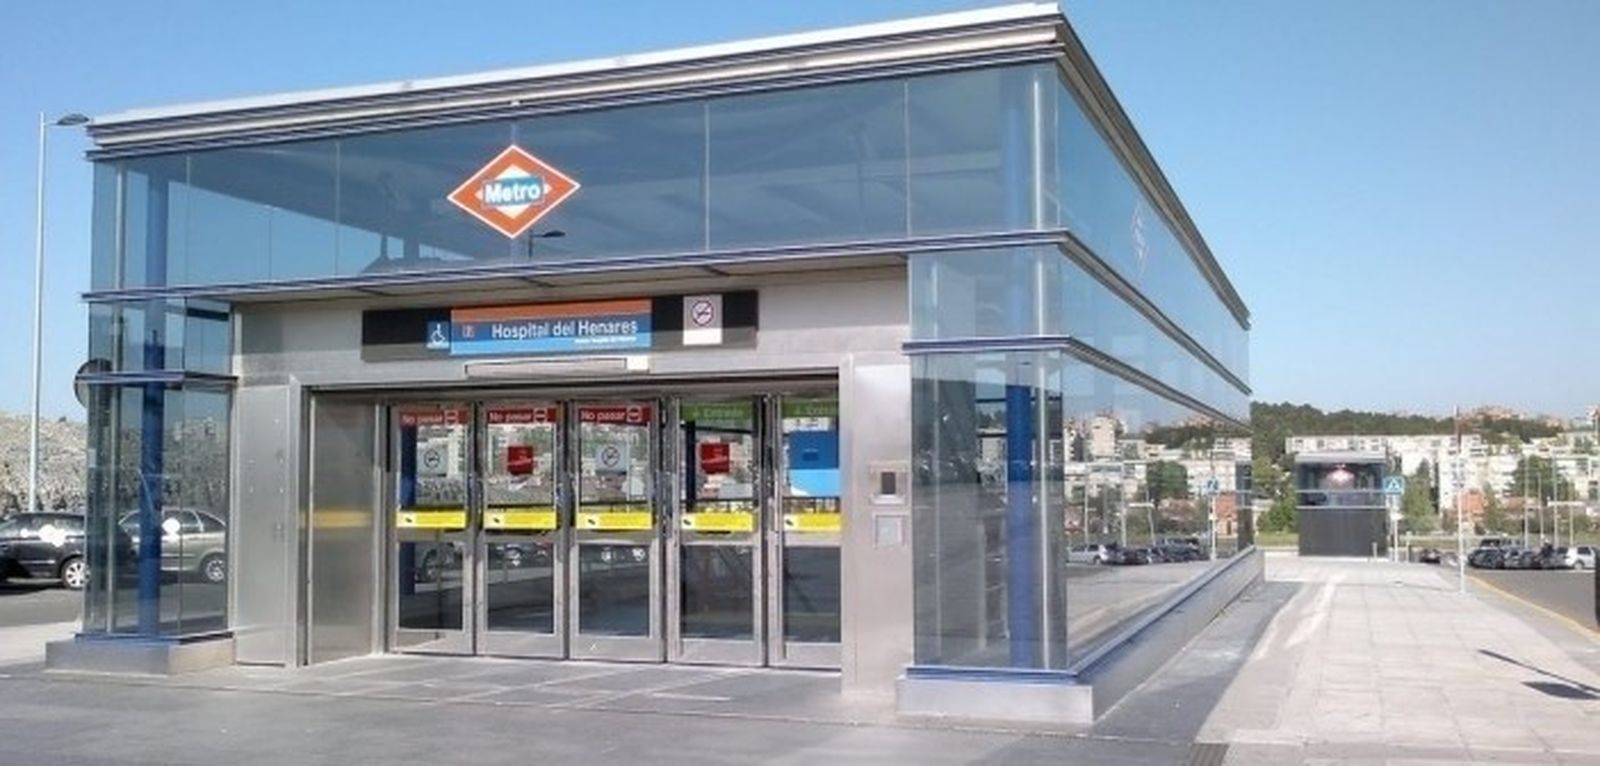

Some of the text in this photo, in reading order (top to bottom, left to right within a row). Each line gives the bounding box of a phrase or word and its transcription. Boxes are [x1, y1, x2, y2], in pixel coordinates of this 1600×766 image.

[484, 182, 541, 203] Metro
[491, 322, 549, 341] Hospital
[552, 321, 575, 336] del
[578, 320, 638, 336] Henares
[402, 413, 416, 425] No
[489, 411, 504, 422] No
[581, 409, 626, 424] No pasar
